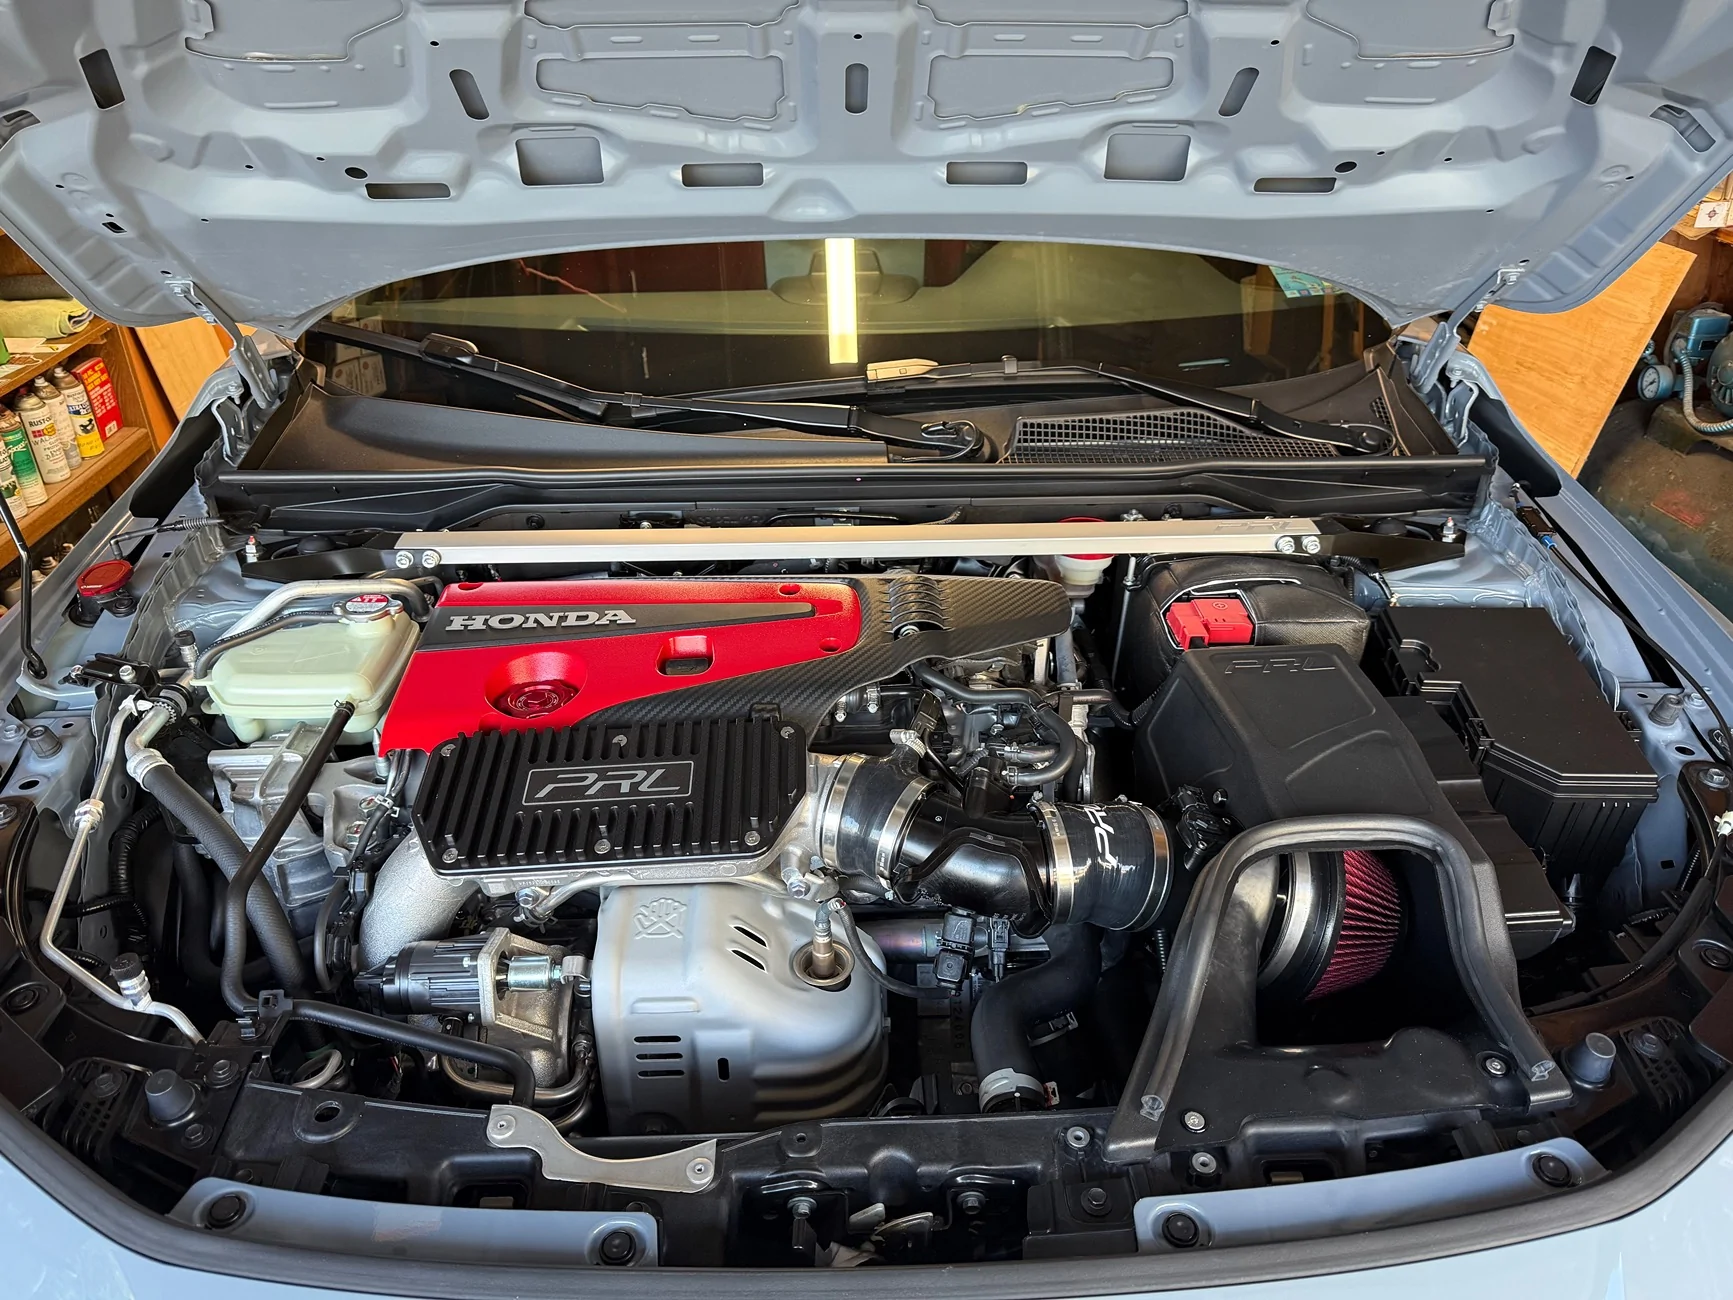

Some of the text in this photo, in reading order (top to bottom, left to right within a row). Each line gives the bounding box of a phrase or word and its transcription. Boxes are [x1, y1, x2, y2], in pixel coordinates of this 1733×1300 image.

[1214, 520, 1309, 532] PRL
[445, 609, 636, 631] HONDA
[1224, 656, 1336, 674] PRL
[534, 768, 681, 798] PRL
